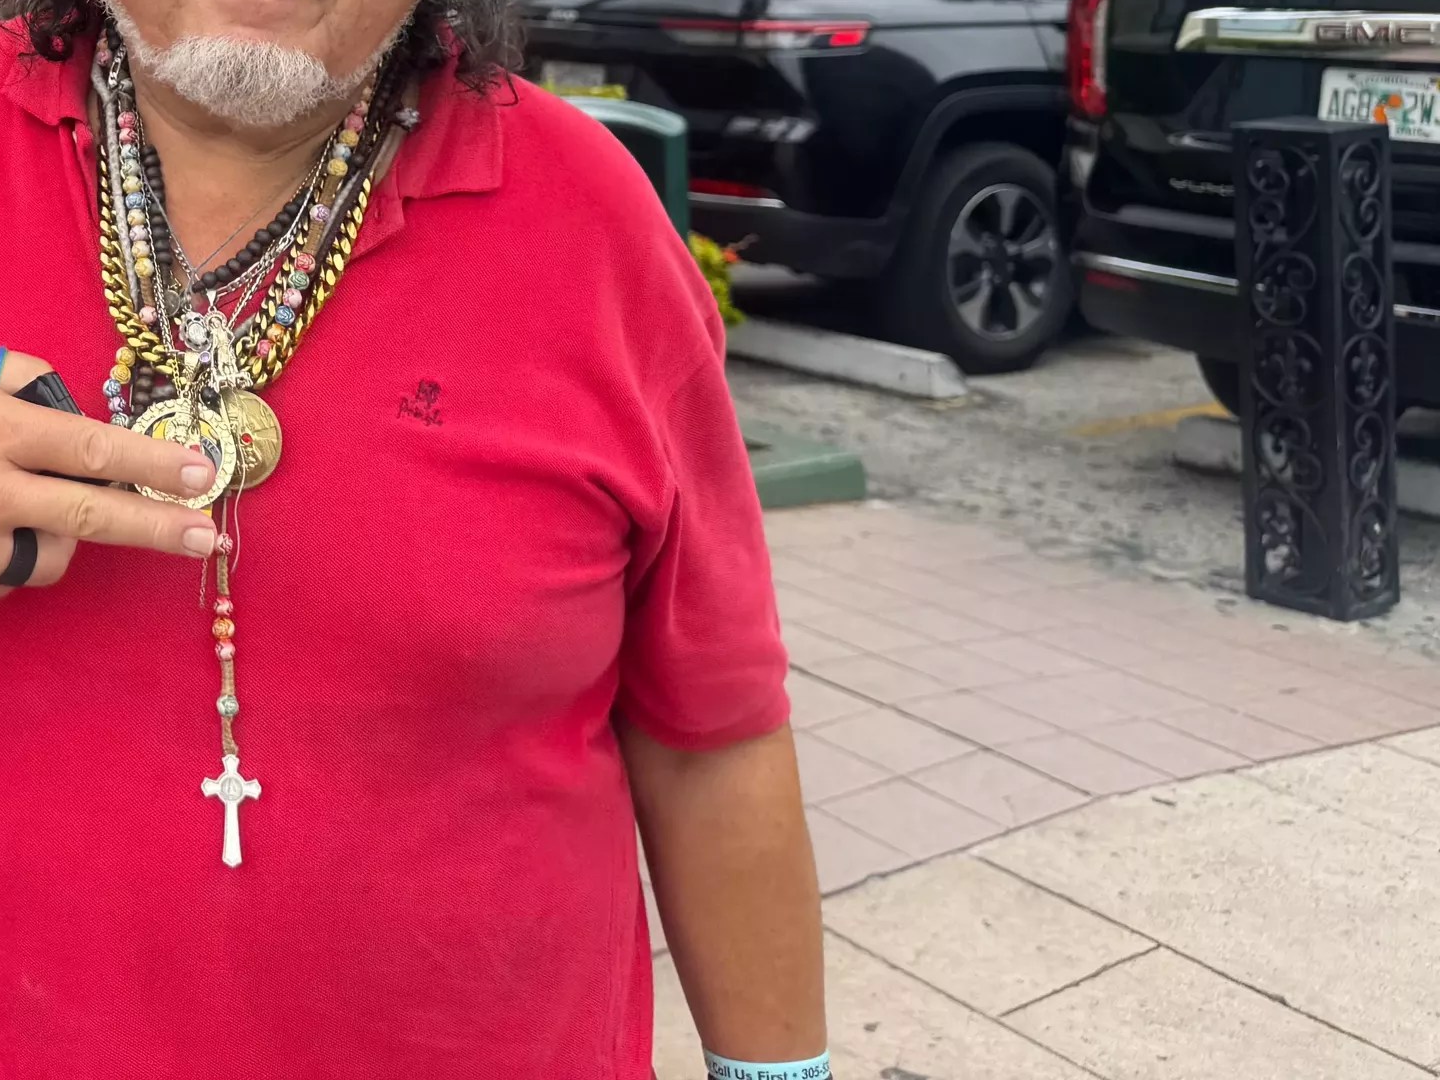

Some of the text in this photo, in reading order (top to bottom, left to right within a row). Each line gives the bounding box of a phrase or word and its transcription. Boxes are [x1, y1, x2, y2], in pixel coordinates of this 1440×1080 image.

[1316, 20, 1437, 46] GMC
[710, 1061, 732, 1079] Call
[734, 1069, 753, 1080] Us
[758, 1070, 789, 1080] First
